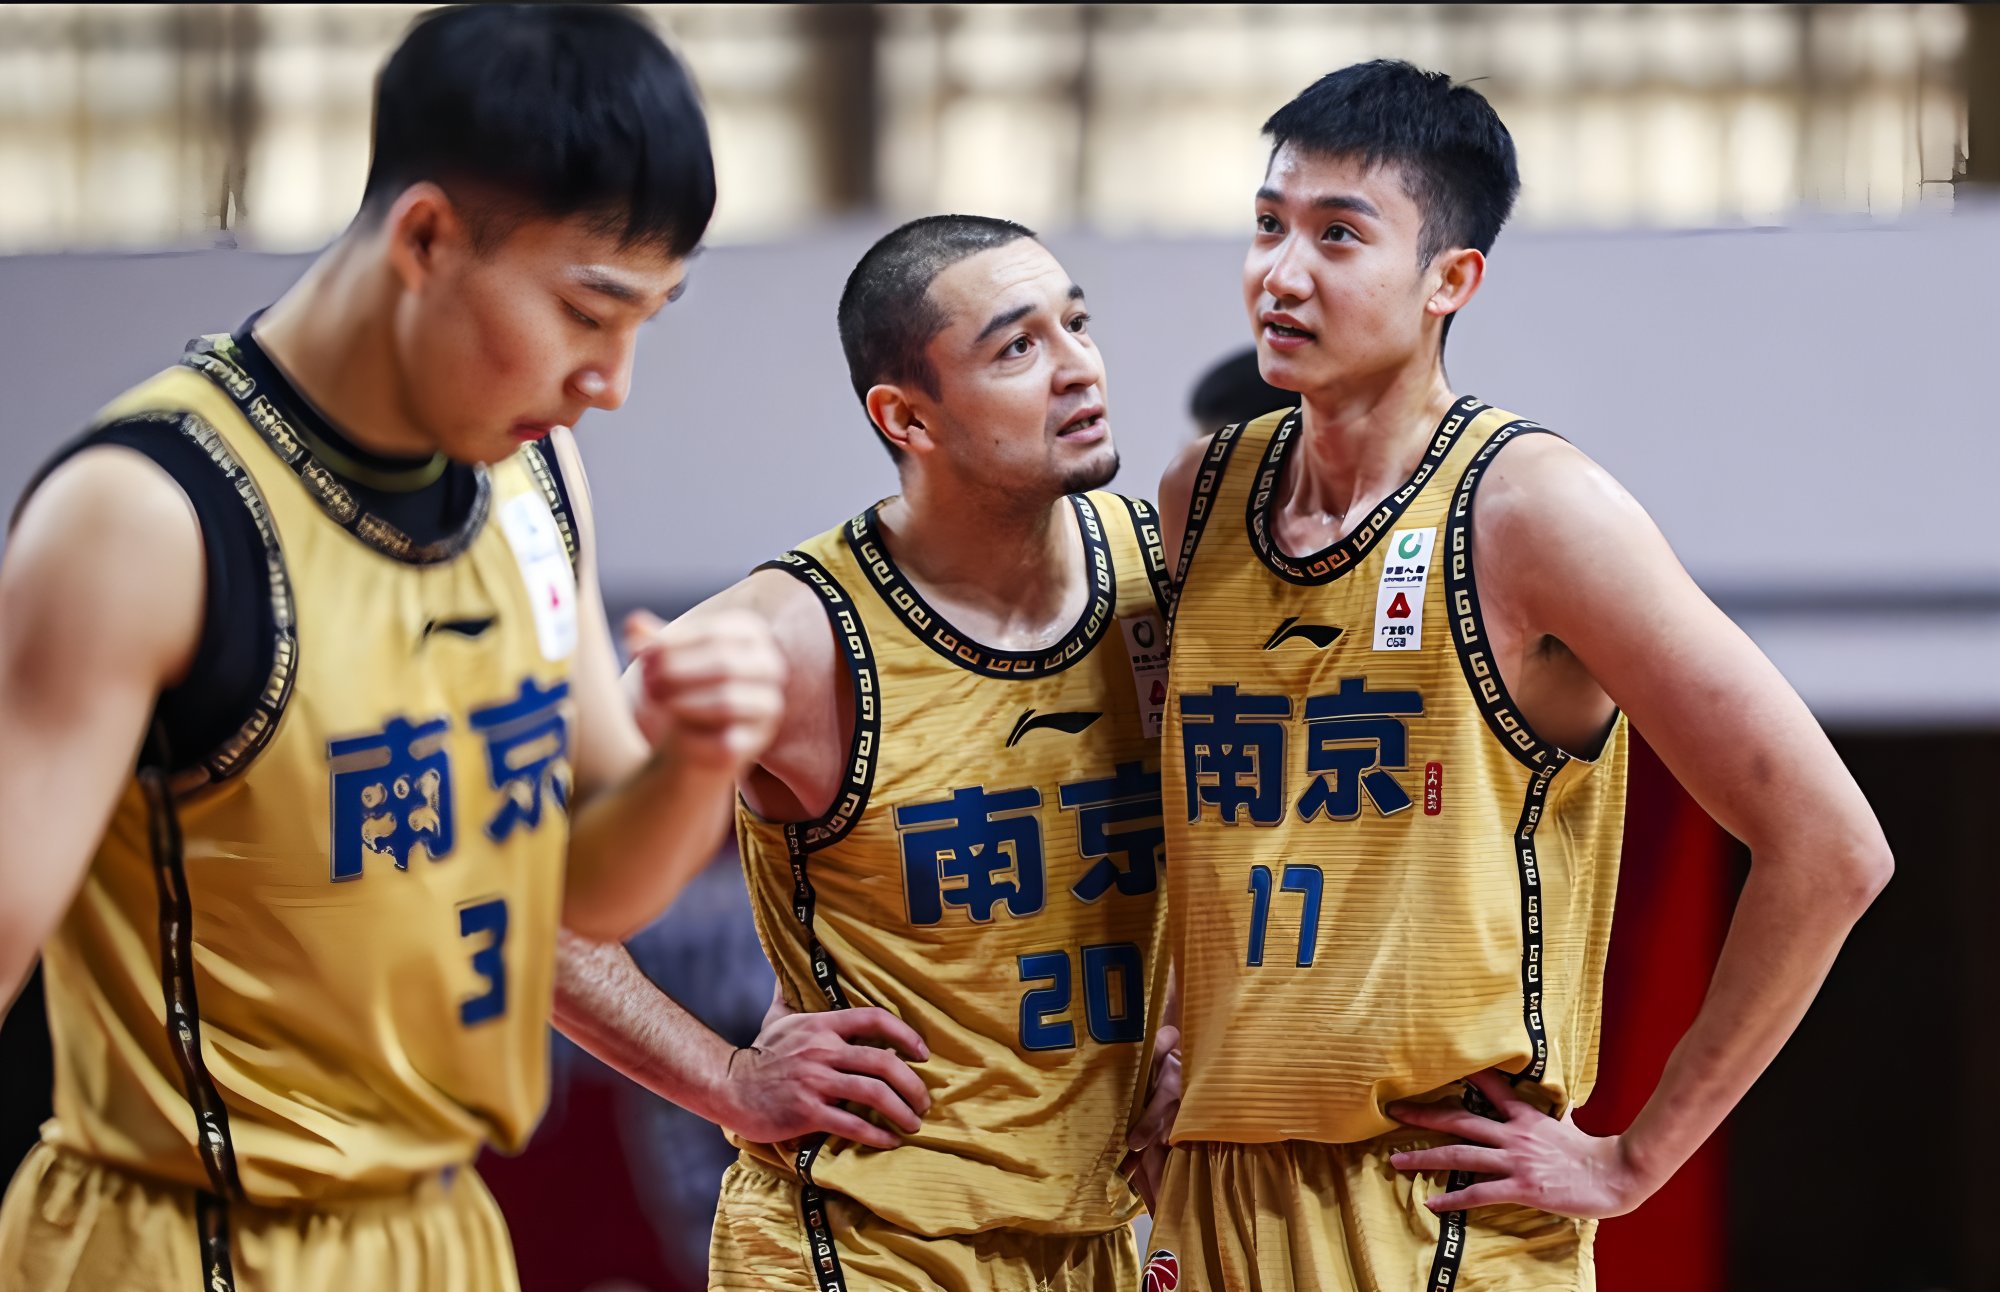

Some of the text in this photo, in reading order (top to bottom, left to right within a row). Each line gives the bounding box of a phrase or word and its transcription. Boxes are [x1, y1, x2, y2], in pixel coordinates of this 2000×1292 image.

[328, 677, 572, 883] 南京
[1180, 677, 1425, 827] 南京
[893, 761, 1164, 927] 南京
[458, 897, 508, 1027] 3
[1246, 864, 1324, 968] 17
[1018, 942, 1145, 1052] 20
